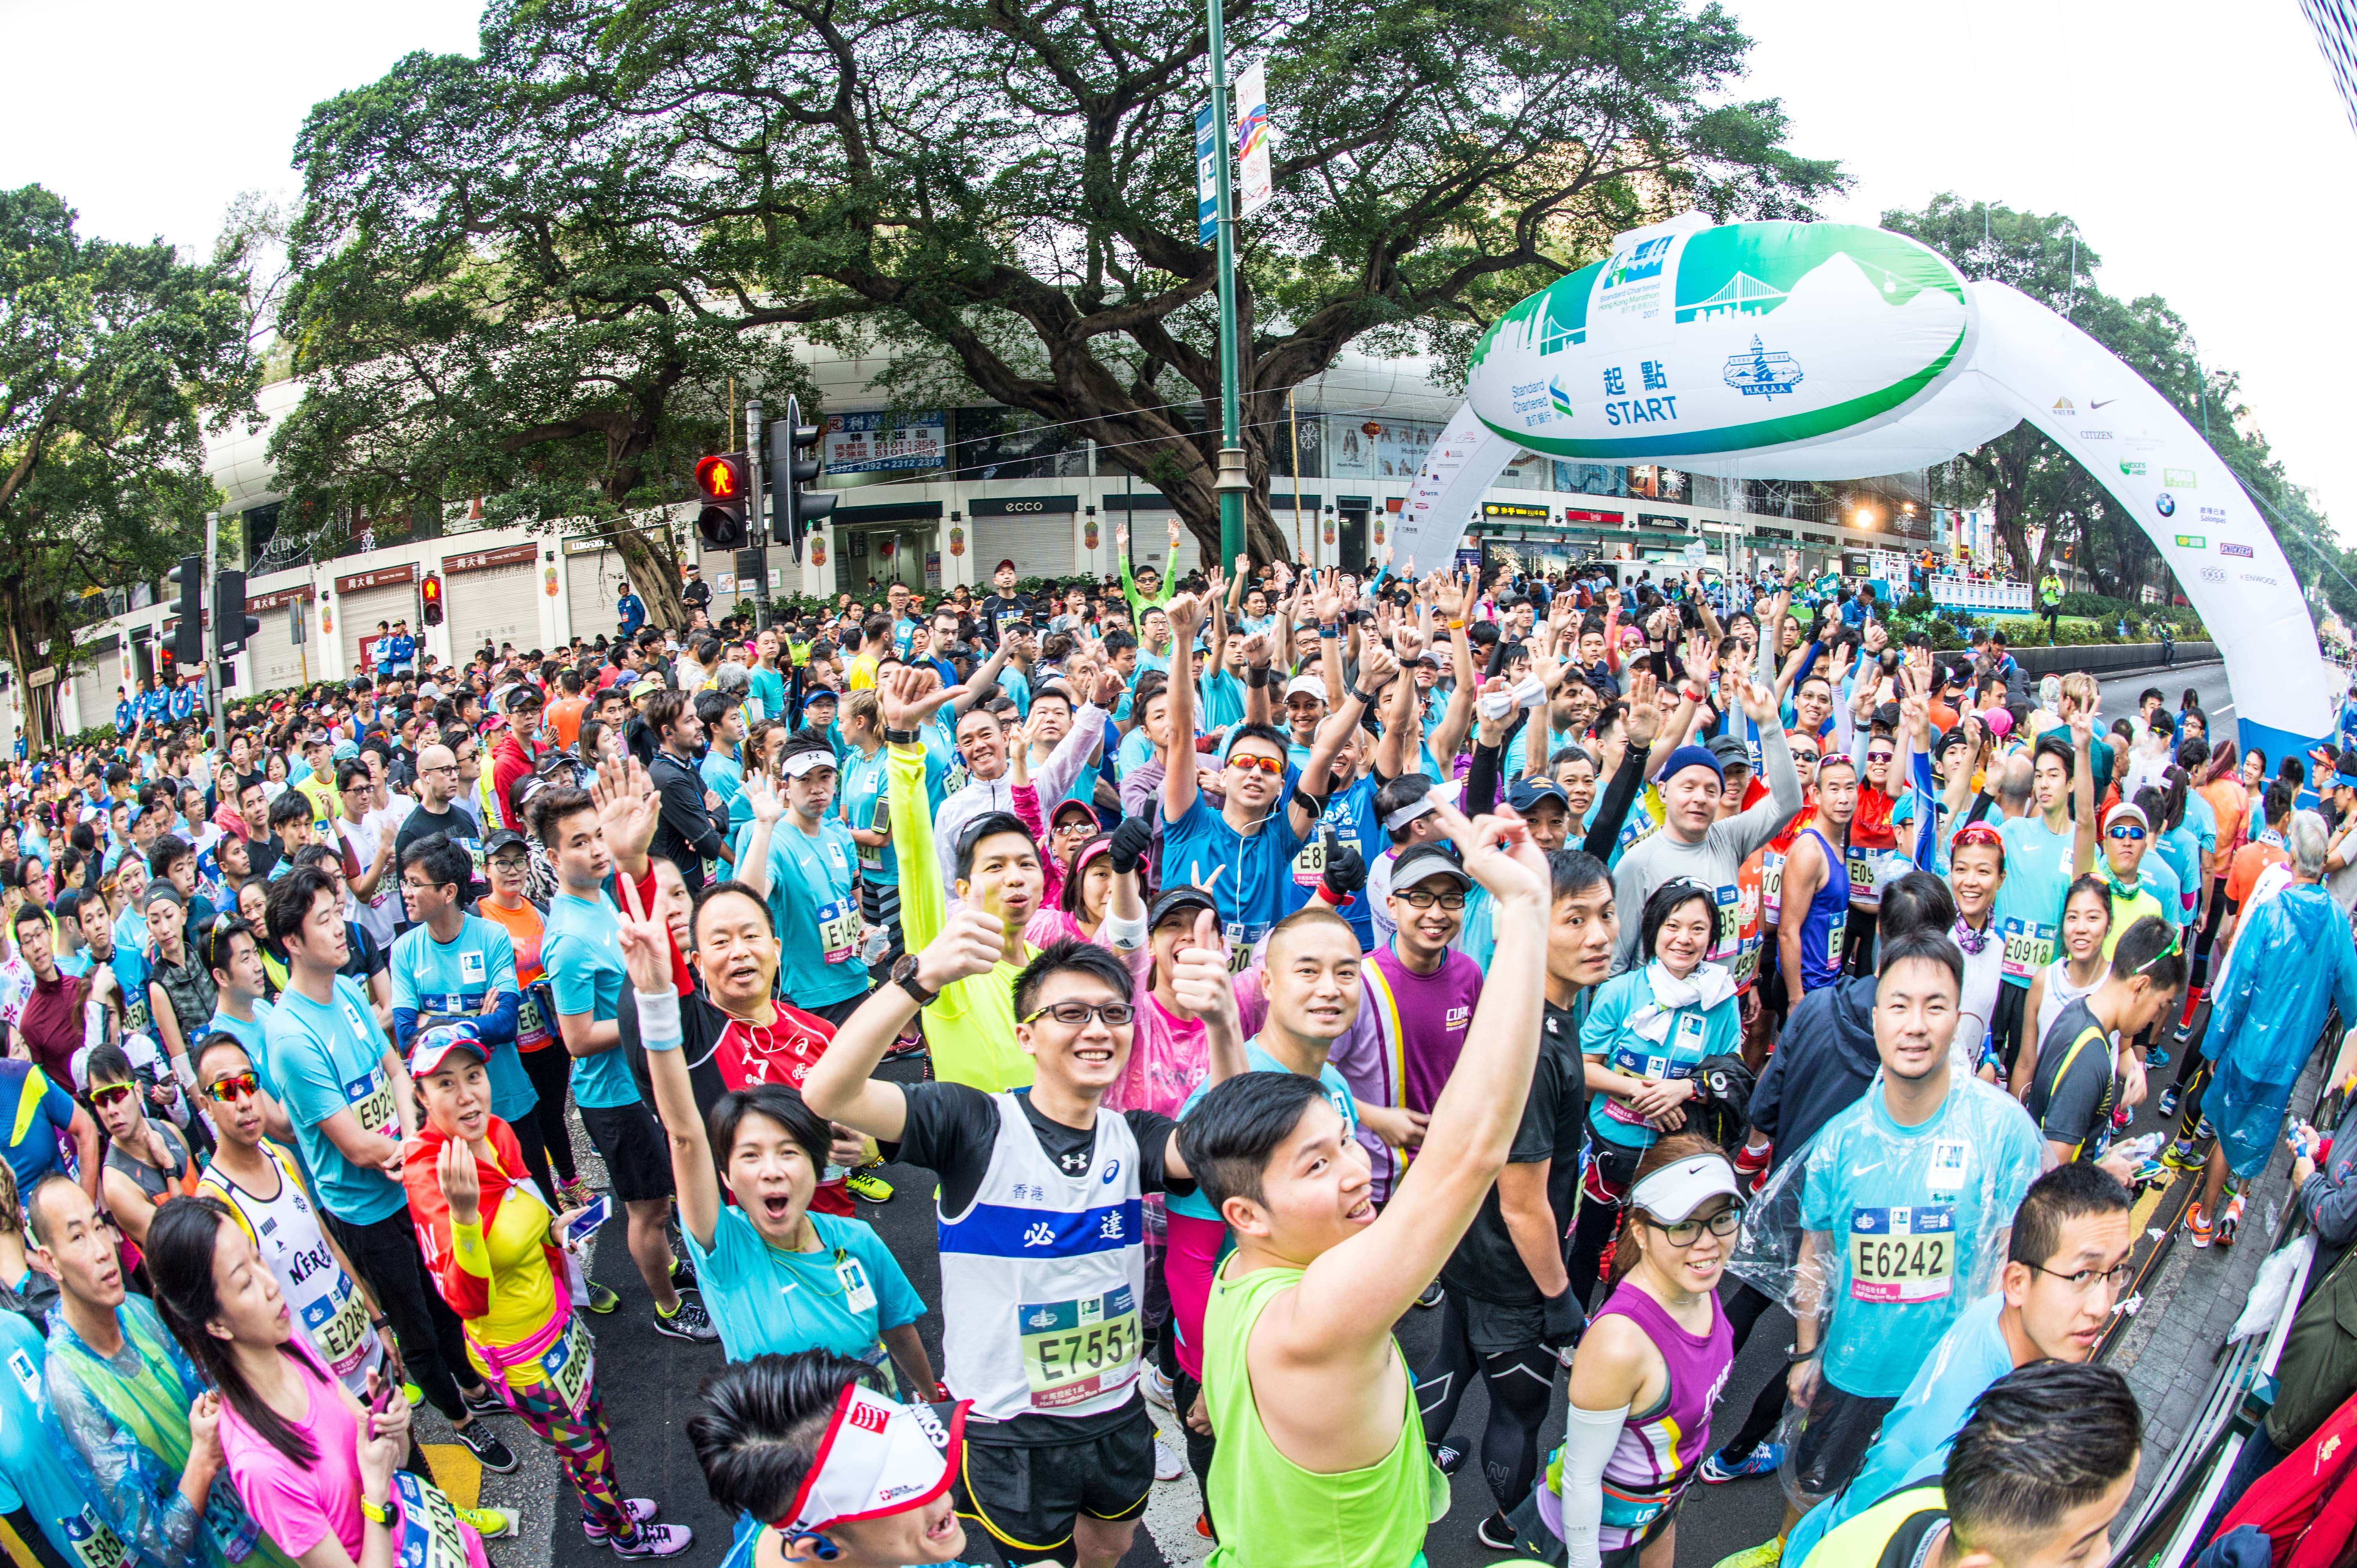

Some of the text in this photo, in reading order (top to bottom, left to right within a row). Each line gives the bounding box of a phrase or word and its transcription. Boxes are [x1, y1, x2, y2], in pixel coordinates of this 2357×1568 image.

[1600, 282, 1660, 302] Standard Chartered
[1598, 292, 1660, 312] Hong Kong Marathon
[1642, 309, 1659, 319] 2017
[1603, 360, 1667, 396] 起點
[1512, 378, 1545, 398] Standard
[1745, 385, 1788, 394] H.K.A.A.A.
[1512, 394, 1548, 414] Chartered
[1606, 395, 1678, 426] START
[2080, 430, 2114, 440] CITIZEN
[830, 464, 854, 473] 2392
[858, 462, 882, 471] 3392
[891, 459, 914, 468] 2312
[918, 458, 941, 467] 2319
[1006, 502, 1043, 512] ecco
[2200, 515, 2227, 524] Salonpas
[2221, 544, 2251, 556] SNICKERS
[457, 555, 486, 569] 周大福
[348, 575, 374, 589] 周大福
[2239, 573, 2277, 586] KENWOOD
[254, 596, 277, 610] 周大福
[2004, 937, 2048, 965] E0918
[1446, 1006, 1471, 1022] CUHK
[1012, 1184, 1044, 1201] 香港
[1023, 1209, 1125, 1248] 必達
[1860, 1240, 1943, 1278] E6242
[1039, 1317, 1137, 1381] E7551
[1039, 1399, 1054, 1407] Half
[1055, 1392, 1084, 1405] Marathon
[1084, 1388, 1097, 1399] Run
[1040, 1384, 1086, 1401] 半馬拉松1組
